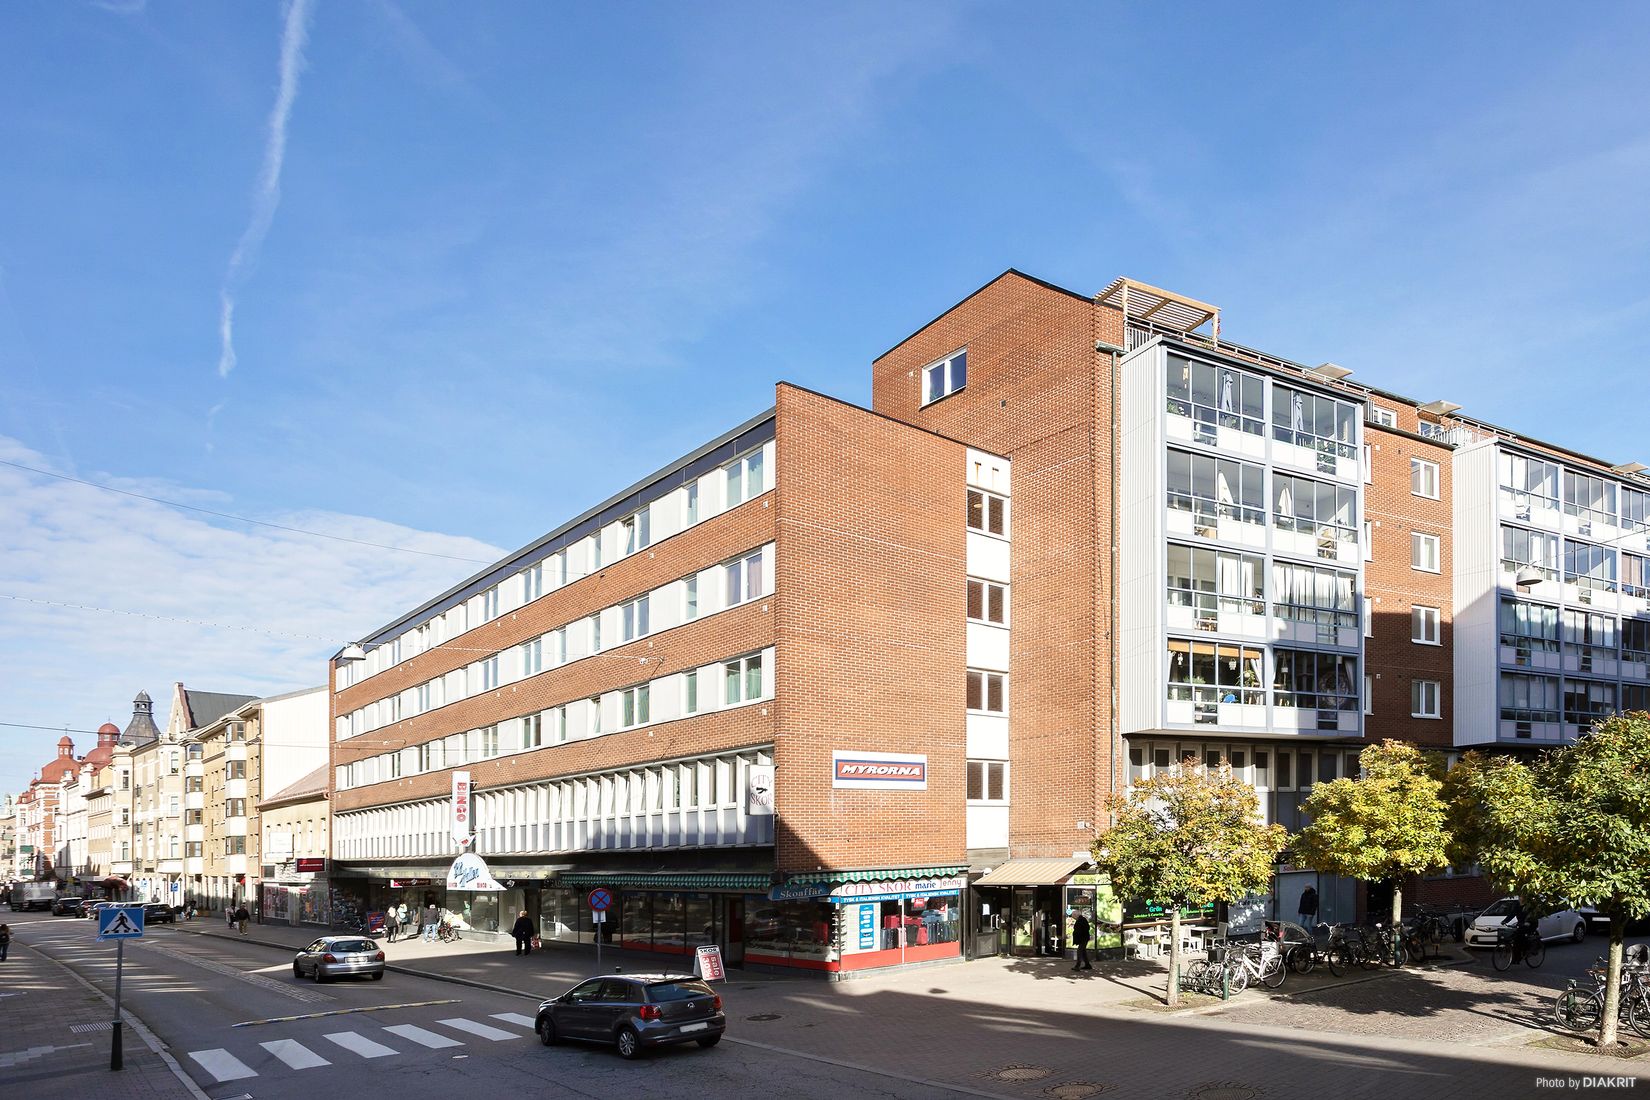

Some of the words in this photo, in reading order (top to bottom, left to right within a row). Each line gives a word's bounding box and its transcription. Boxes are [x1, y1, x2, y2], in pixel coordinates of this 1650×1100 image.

[841, 764, 921, 776] MYRORNA
[751, 774, 773, 788] CITY
[456, 782, 467, 822] BINGO
[750, 792, 773, 806] SKOR
[845, 884, 875, 895] CITY
[879, 881, 912, 892] SKOR
[915, 880, 937, 889] marie
[703, 957, 713, 978] 30%
[711, 956, 720, 976] sale
